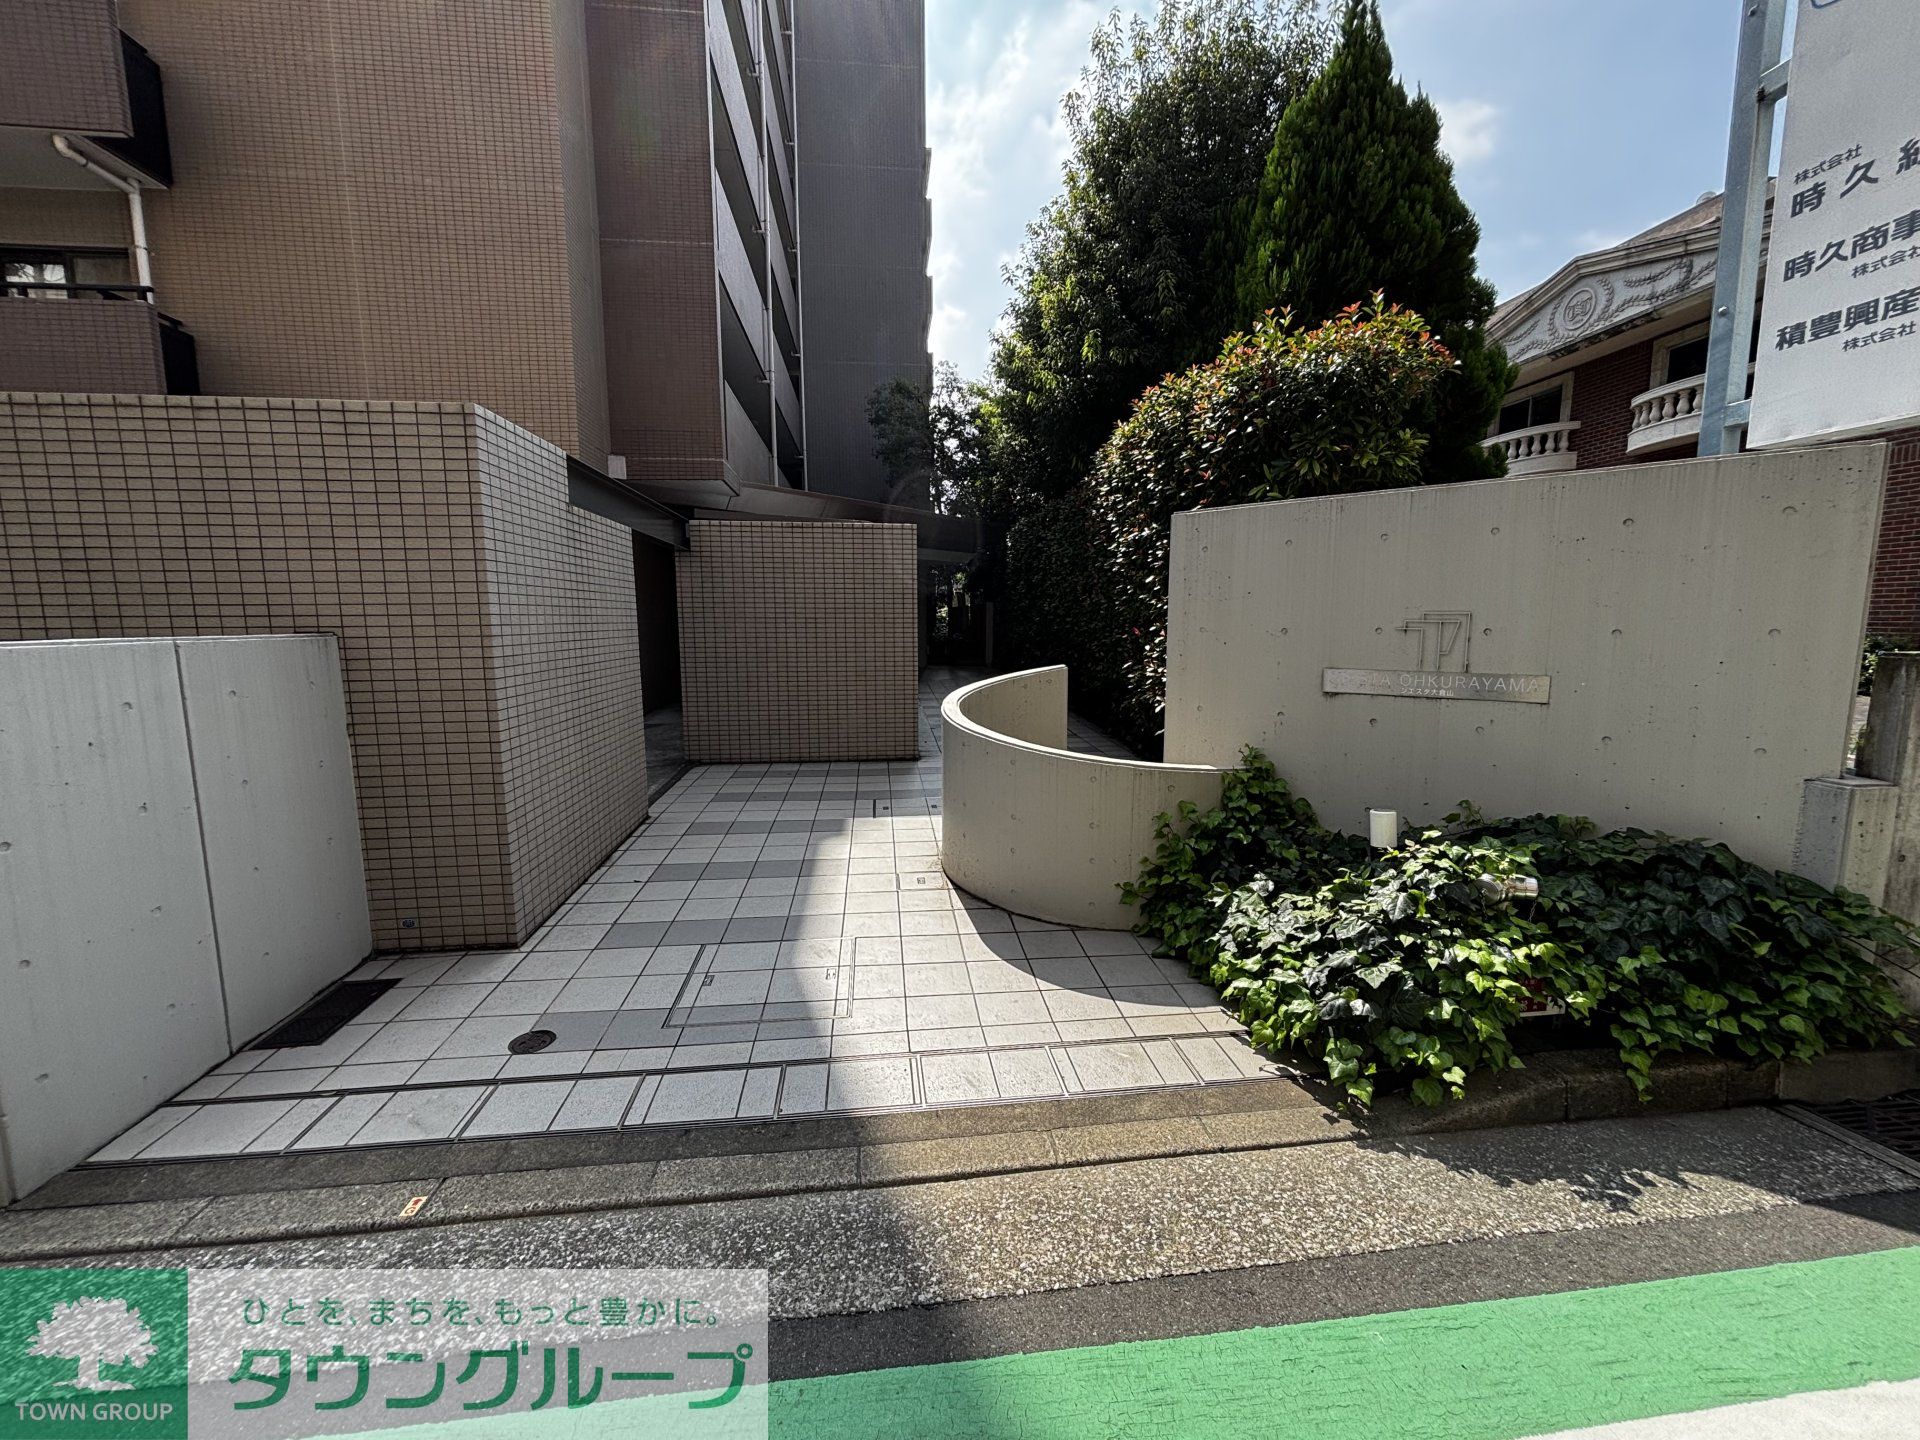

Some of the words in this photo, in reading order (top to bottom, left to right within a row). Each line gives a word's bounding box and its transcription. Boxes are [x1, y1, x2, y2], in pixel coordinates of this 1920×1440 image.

[1793, 143, 1863, 185] 株式会社
[1782, 209, 1920, 282] 時久商事
[1842, 320, 1917, 352] 株式会社
[1399, 673, 1539, 693] OHKURAYAMA
